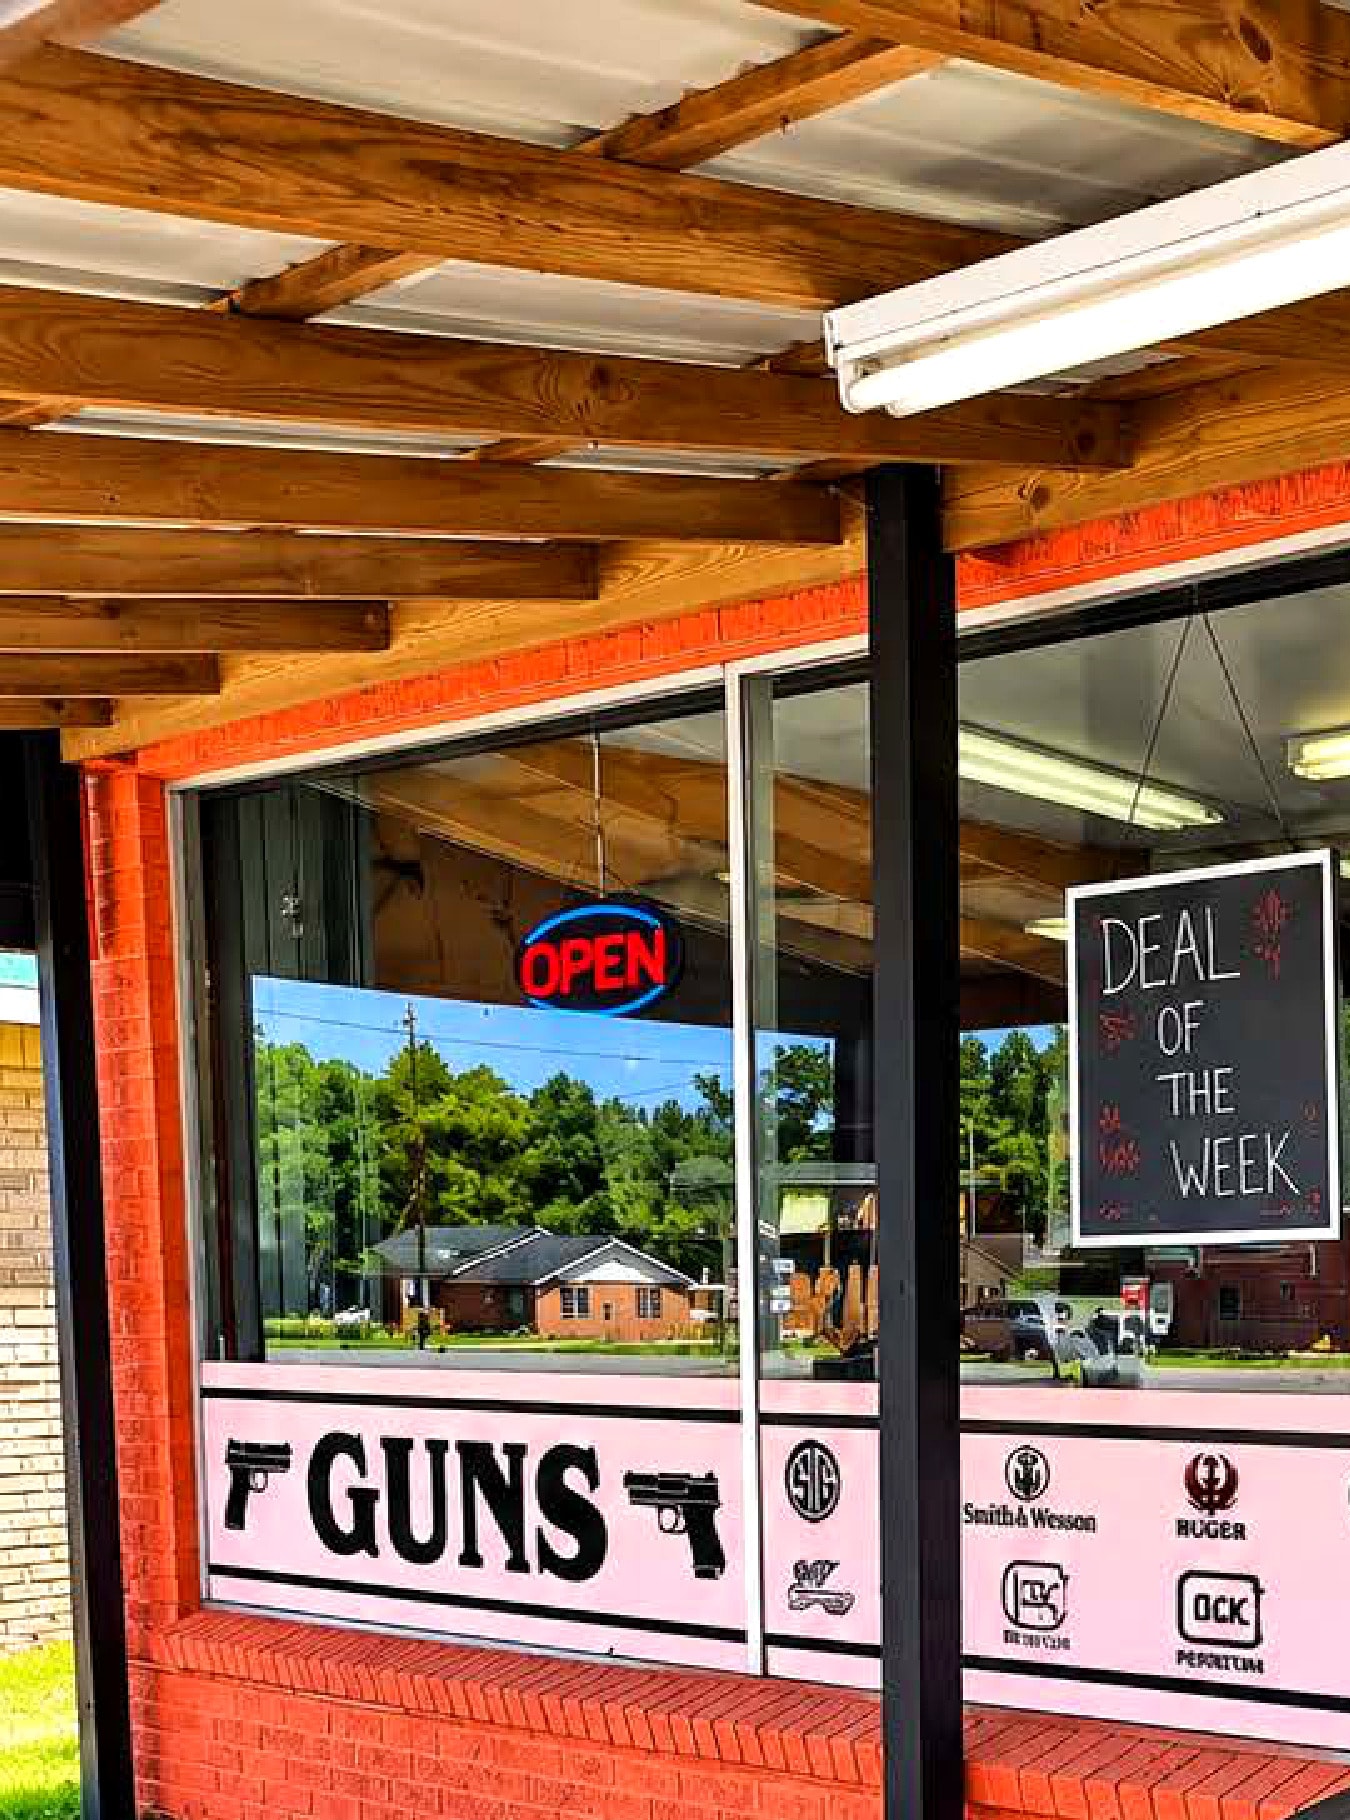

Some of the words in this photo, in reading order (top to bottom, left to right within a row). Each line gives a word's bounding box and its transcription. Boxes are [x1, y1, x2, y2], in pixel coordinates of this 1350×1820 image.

[522, 927, 666, 996] OPEN
[1102, 906, 1241, 995] DEAL
[1157, 1000, 1204, 1056] OF
[1155, 1067, 1235, 1116] THE
[1169, 1132, 1301, 1198] WEEK
[307, 1430, 609, 1583] GUNS
[963, 1502, 1014, 1526] Smith
[1030, 1507, 1097, 1534] Wesson
